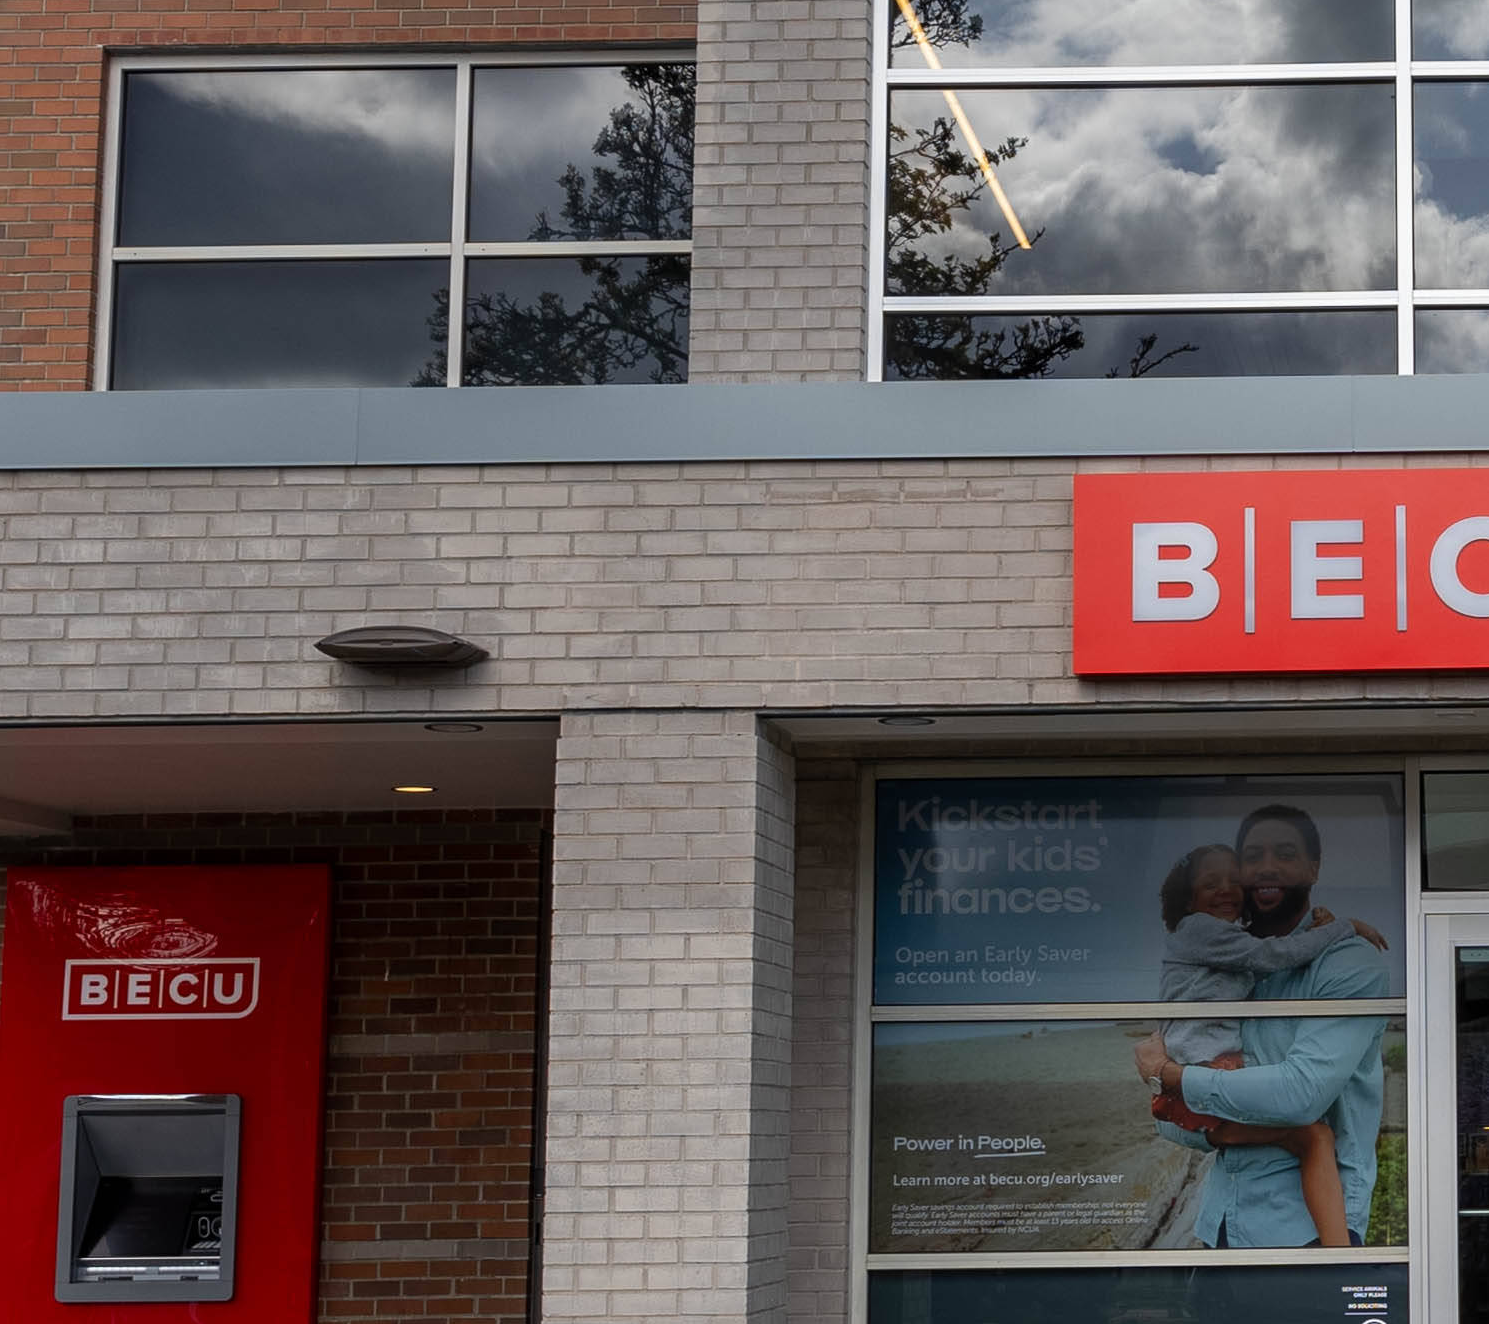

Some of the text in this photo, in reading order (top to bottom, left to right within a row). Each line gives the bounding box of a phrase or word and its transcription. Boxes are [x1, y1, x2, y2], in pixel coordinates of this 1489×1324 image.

[897, 796, 1104, 832] Kickstart
[897, 846, 996, 882] your
[897, 878, 1102, 915] finances.
[895, 945, 1091, 967] Open an Early Saver
[894, 966, 1042, 987] account today.
[80, 972, 244, 1006] BECU
[894, 1134, 1046, 1152] Power in People.
[893, 1172, 1125, 1188] Learn more at becu.org/earlysaver
[891, 1204, 909, 1213] Early
[909, 1203, 928, 1212] Saver
[956, 1203, 984, 1211] account
[985, 1202, 1014, 1212] required
[931, 1211, 947, 1220] Early
[949, 1211, 968, 1219] Saver
[968, 1211, 1000, 1219] accounts
[1043, 1210, 1065, 1219] parent
[1076, 1209, 1093, 1218] legal
[963, 1219, 996, 1227] Members
[1015, 1218, 1025, 1226] be
[1059, 1218, 1078, 1227] years
[1079, 1217, 1091, 1225] old
[1092, 1217, 1100, 1225] to
[1124, 1217, 1150, 1225] Online
[891, 1228, 919, 1237] Banking
[1008, 1227, 1016, 1236] by
